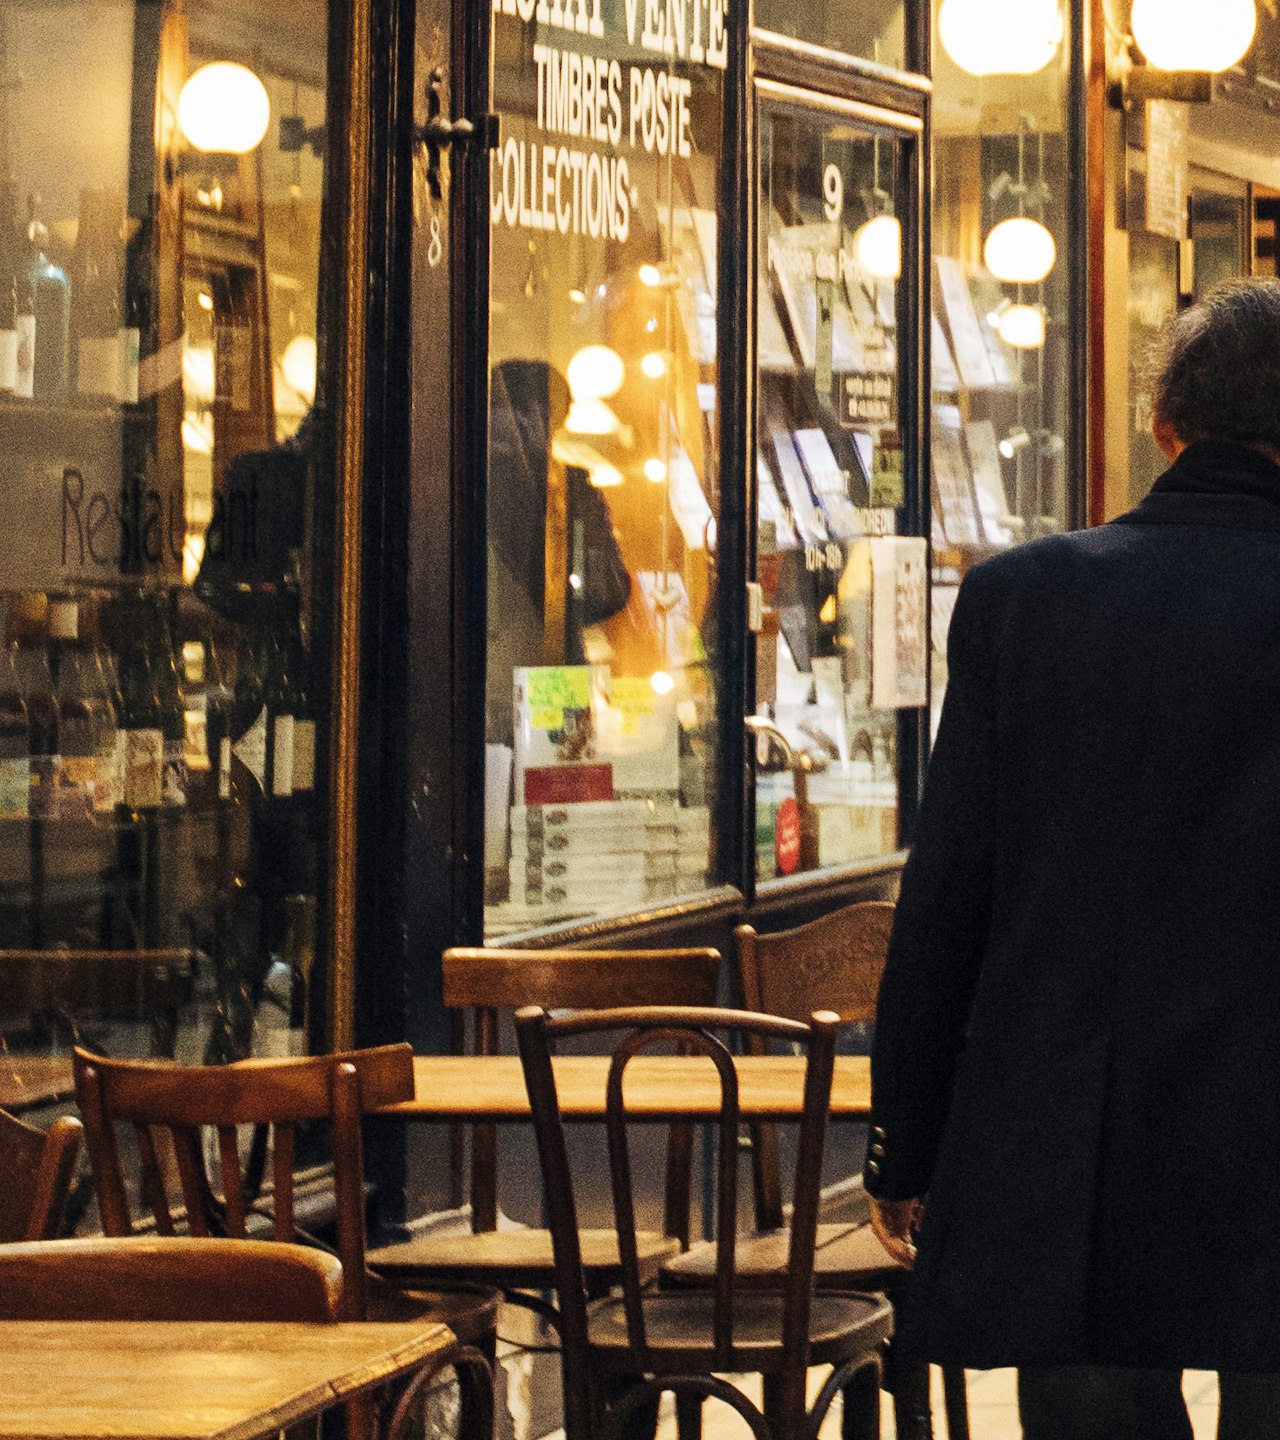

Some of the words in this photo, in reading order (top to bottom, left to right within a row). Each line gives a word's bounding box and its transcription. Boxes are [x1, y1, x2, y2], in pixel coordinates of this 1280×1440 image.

[533, 43, 623, 147] TIMBRES
[629, 65, 693, 158] POSTE
[490, 136, 630, 244] COLLECTIONS
[823, 163, 844, 221] 9
[427, 216, 442, 267] 8
